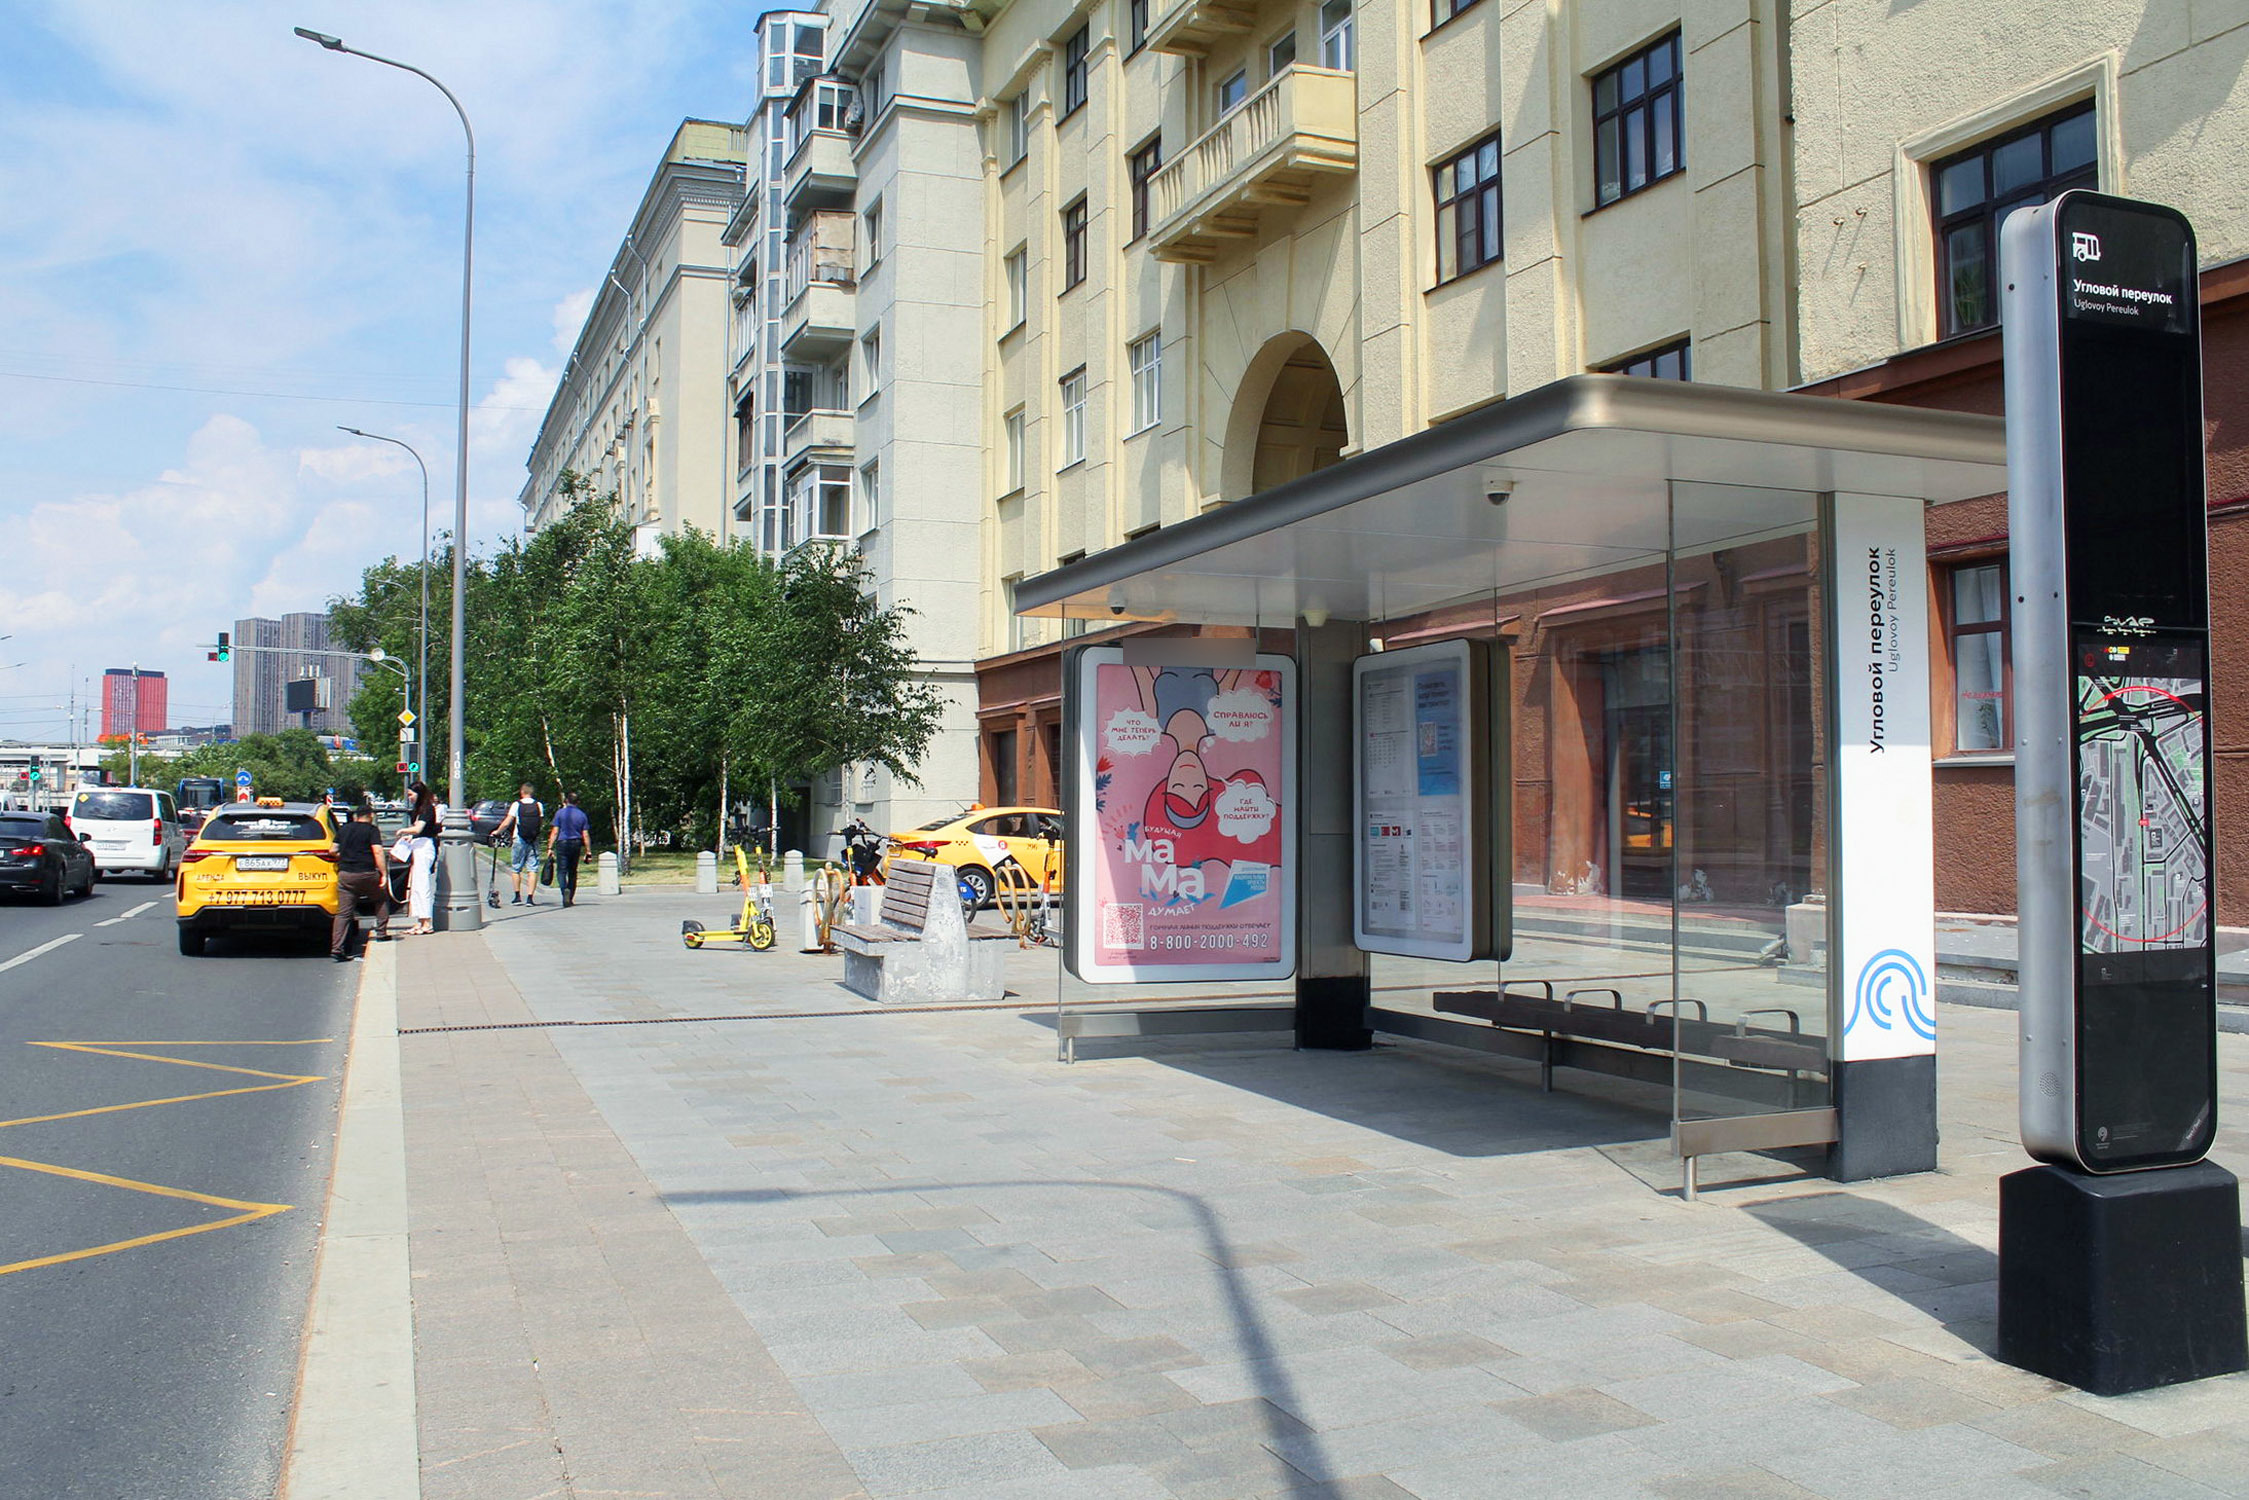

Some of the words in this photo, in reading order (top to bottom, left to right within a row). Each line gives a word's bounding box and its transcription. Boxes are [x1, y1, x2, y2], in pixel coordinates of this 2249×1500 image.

[2073, 279, 2119, 297] Угловой
[2121, 288, 2172, 304] переулок
[2073, 298, 2105, 313] Uglovoy
[2106, 302, 2139, 315] Pereulok
[1885, 548, 1897, 610] Pereulok
[1868, 547, 1885, 654] переулок
[1887, 615, 1900, 672] Uglovoy
[1213, 711, 1268, 719] СПРАВЛЮСЬ
[1868, 662, 1884, 754] Угловой
[1144, 826, 1182, 838] БУДУЩАЯ
[298, 872, 328, 881] ВЫКУП
[209, 892, 222, 904] +7
[226, 891, 248, 904] 977
[252, 891, 274, 904] 713
[277, 890, 306, 904] 0777
[1148, 902, 1196, 917] ДУМАЕТ
[1150, 933, 1268, 949] 8-800-2000-492
